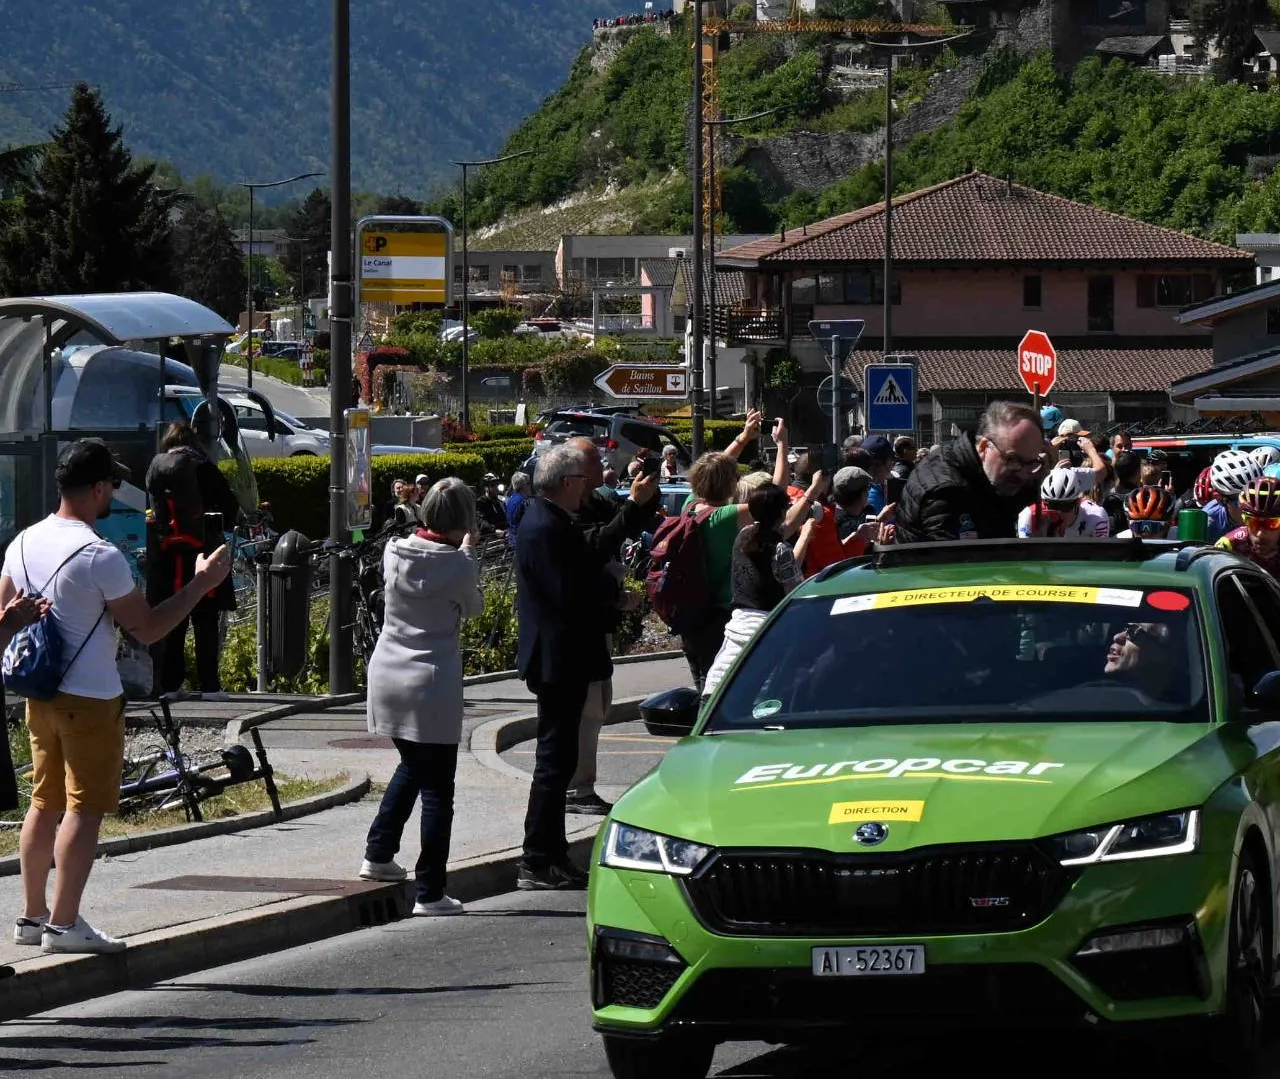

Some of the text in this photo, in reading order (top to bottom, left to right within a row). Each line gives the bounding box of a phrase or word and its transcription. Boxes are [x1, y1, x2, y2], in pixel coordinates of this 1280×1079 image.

[363, 259, 393, 267] Le Canal
[1022, 351, 1052, 376] STOP
[630, 370, 655, 380] Bains
[621, 383, 663, 394] de Saillon
[889, 589, 1090, 603] 2 DIRECTEUR DE COURSE 1
[734, 757, 1066, 784] Europcar
[843, 805, 909, 816] DIRECTION
[855, 948, 917, 971] 52367
